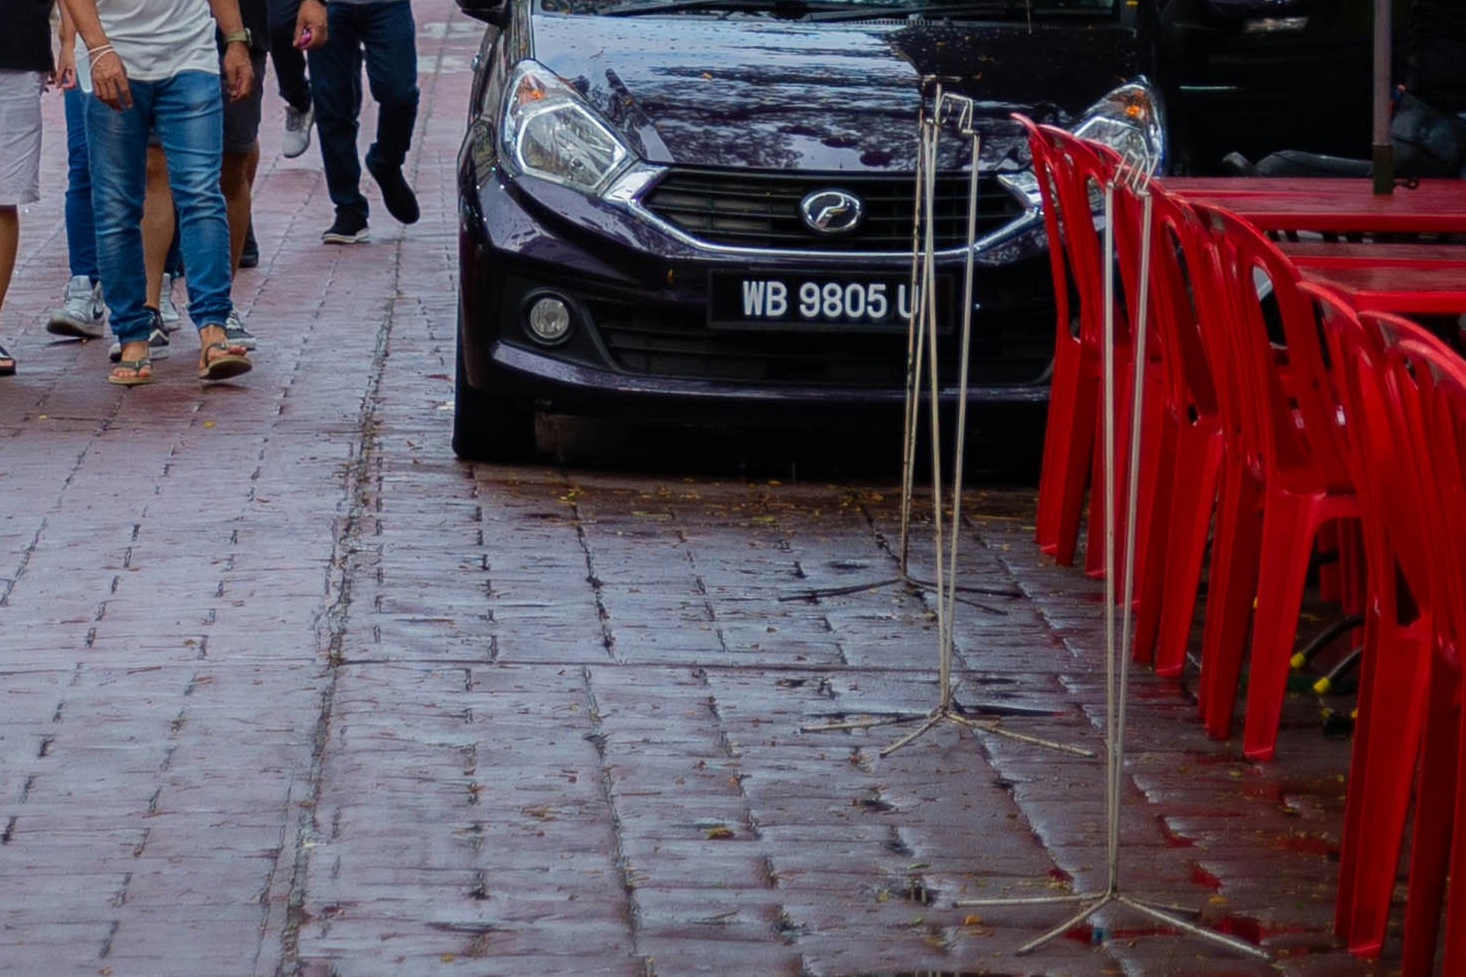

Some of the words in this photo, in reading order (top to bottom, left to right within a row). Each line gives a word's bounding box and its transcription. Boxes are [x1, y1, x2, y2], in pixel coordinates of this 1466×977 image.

[742, 280, 788, 317] WB
[799, 281, 888, 319] 9805
[897, 284, 920, 320] U
